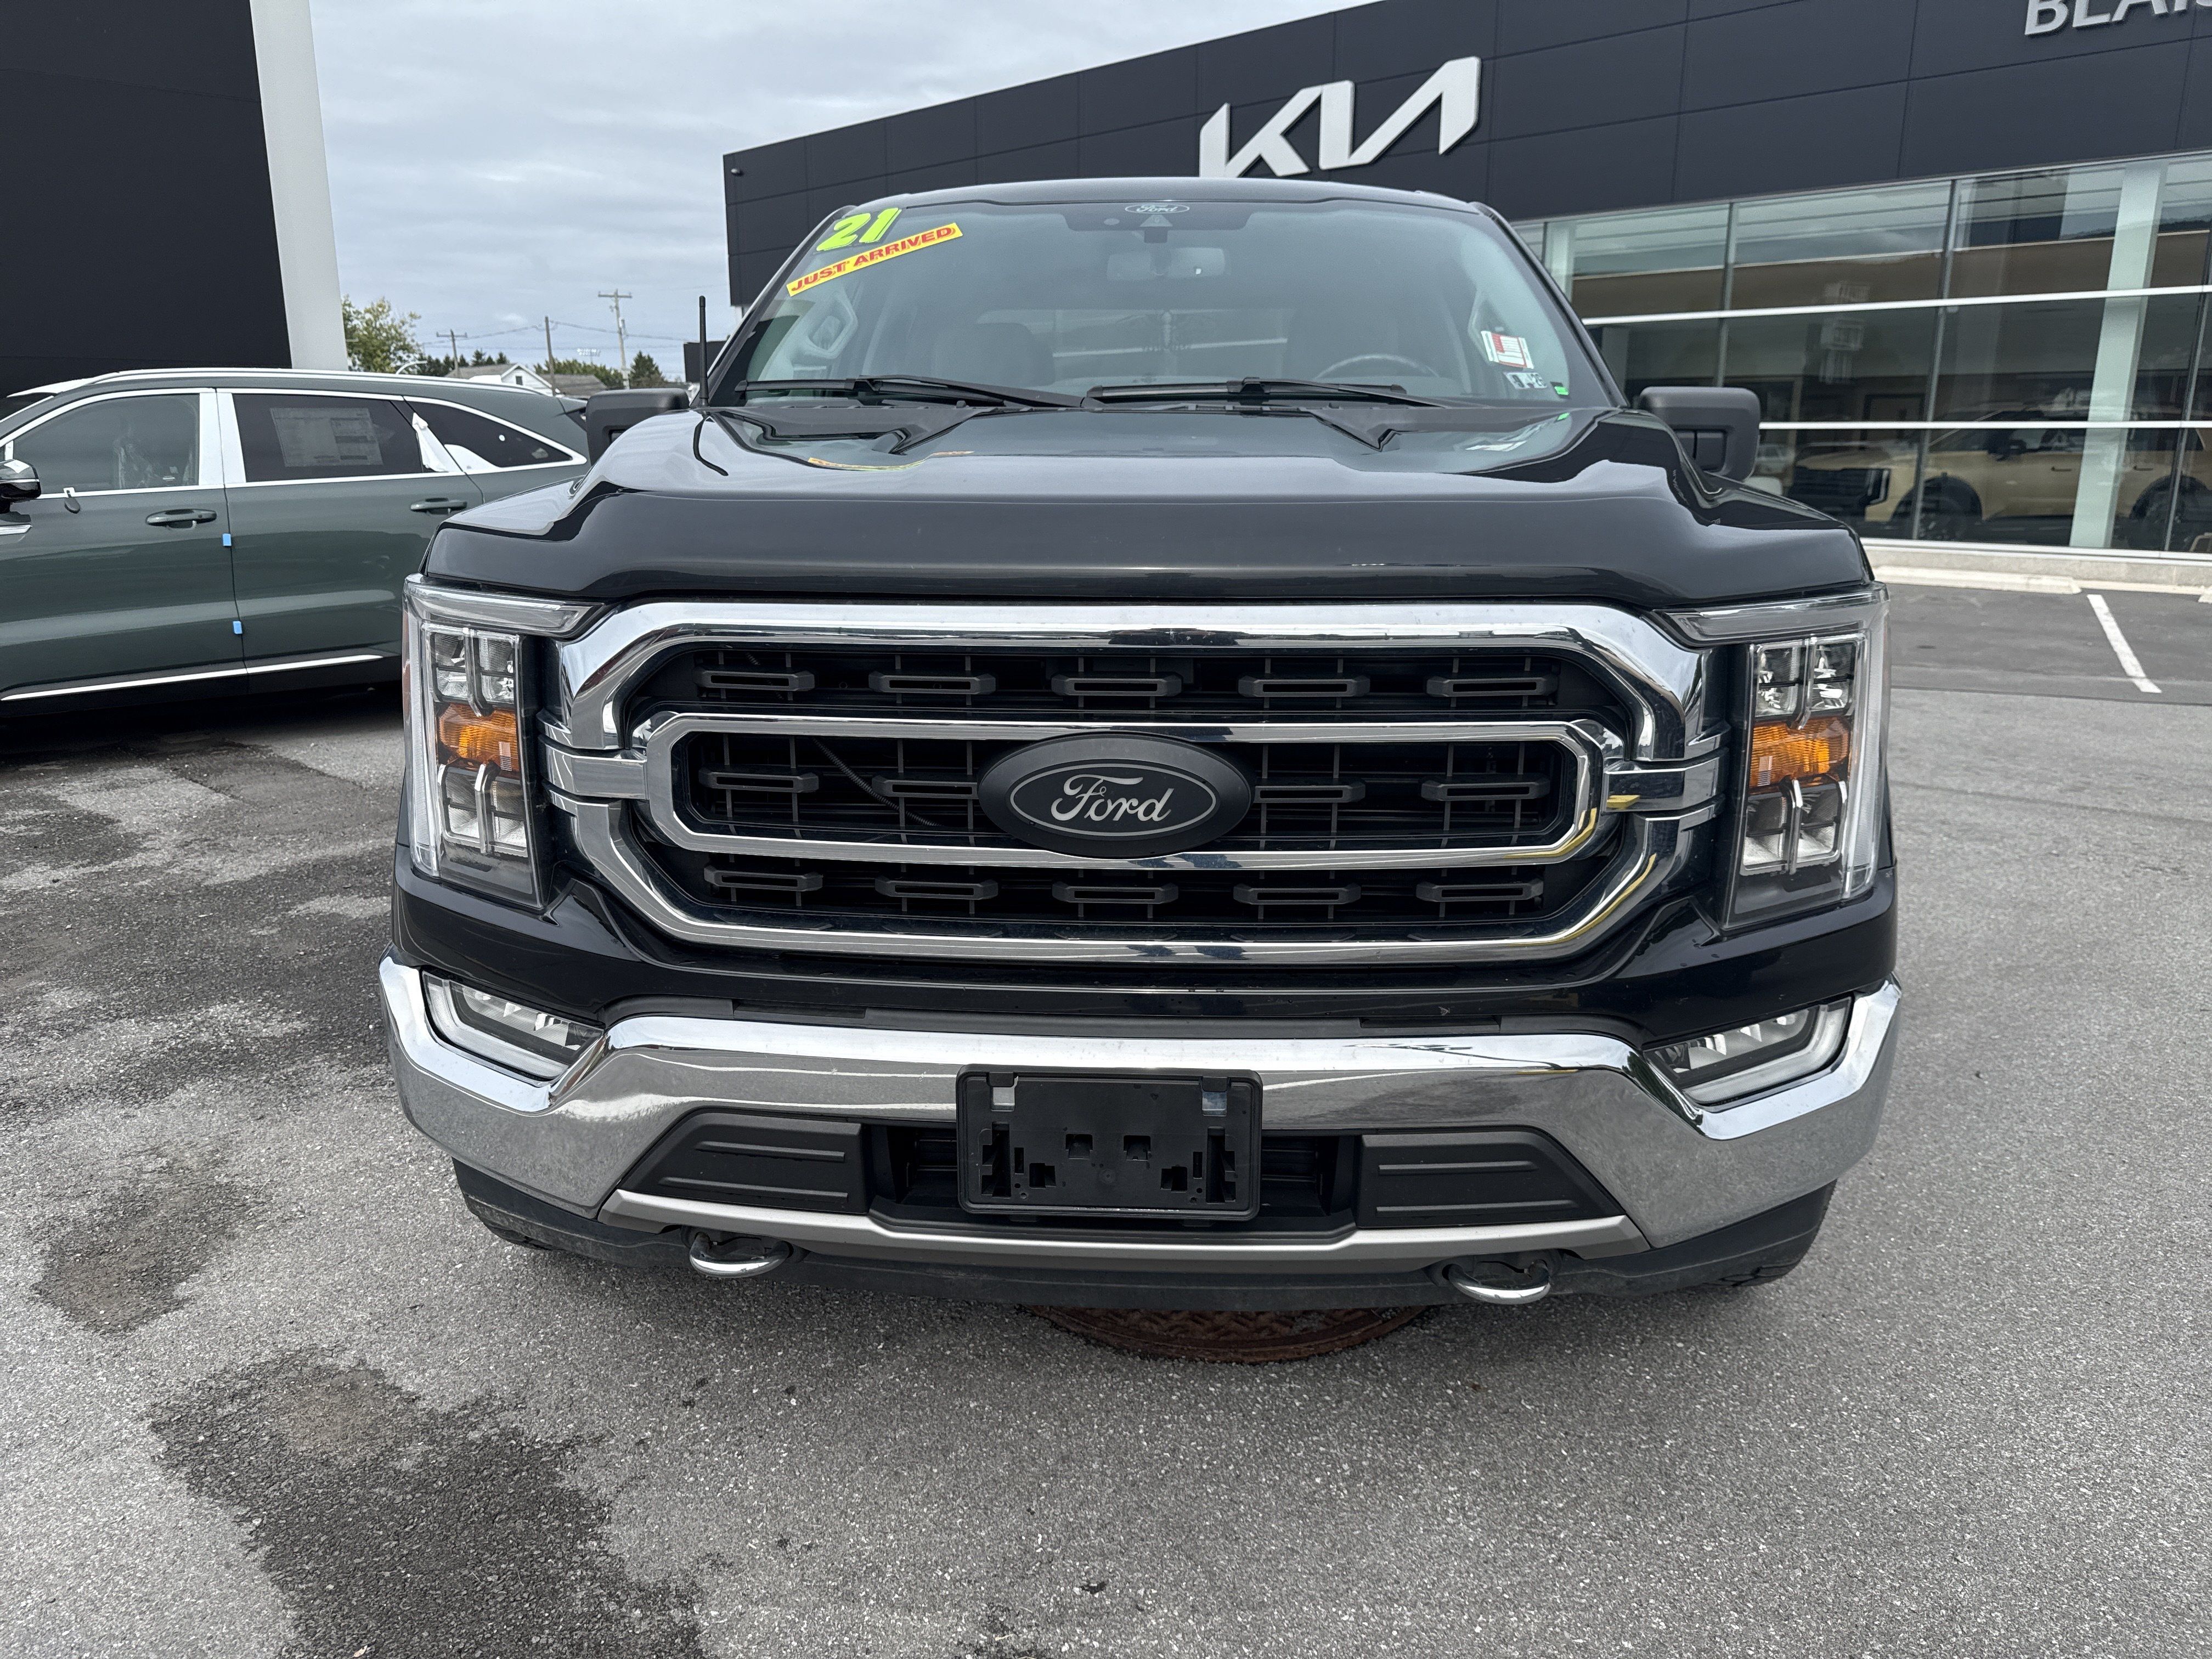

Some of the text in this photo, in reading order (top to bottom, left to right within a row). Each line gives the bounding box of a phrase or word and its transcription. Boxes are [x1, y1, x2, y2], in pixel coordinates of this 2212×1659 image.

[816, 207, 902, 251] 21
[1136, 204, 1178, 213] Ford
[791, 227, 956, 291] JUST ARRIVED
[1051, 774, 1175, 822] Ford
